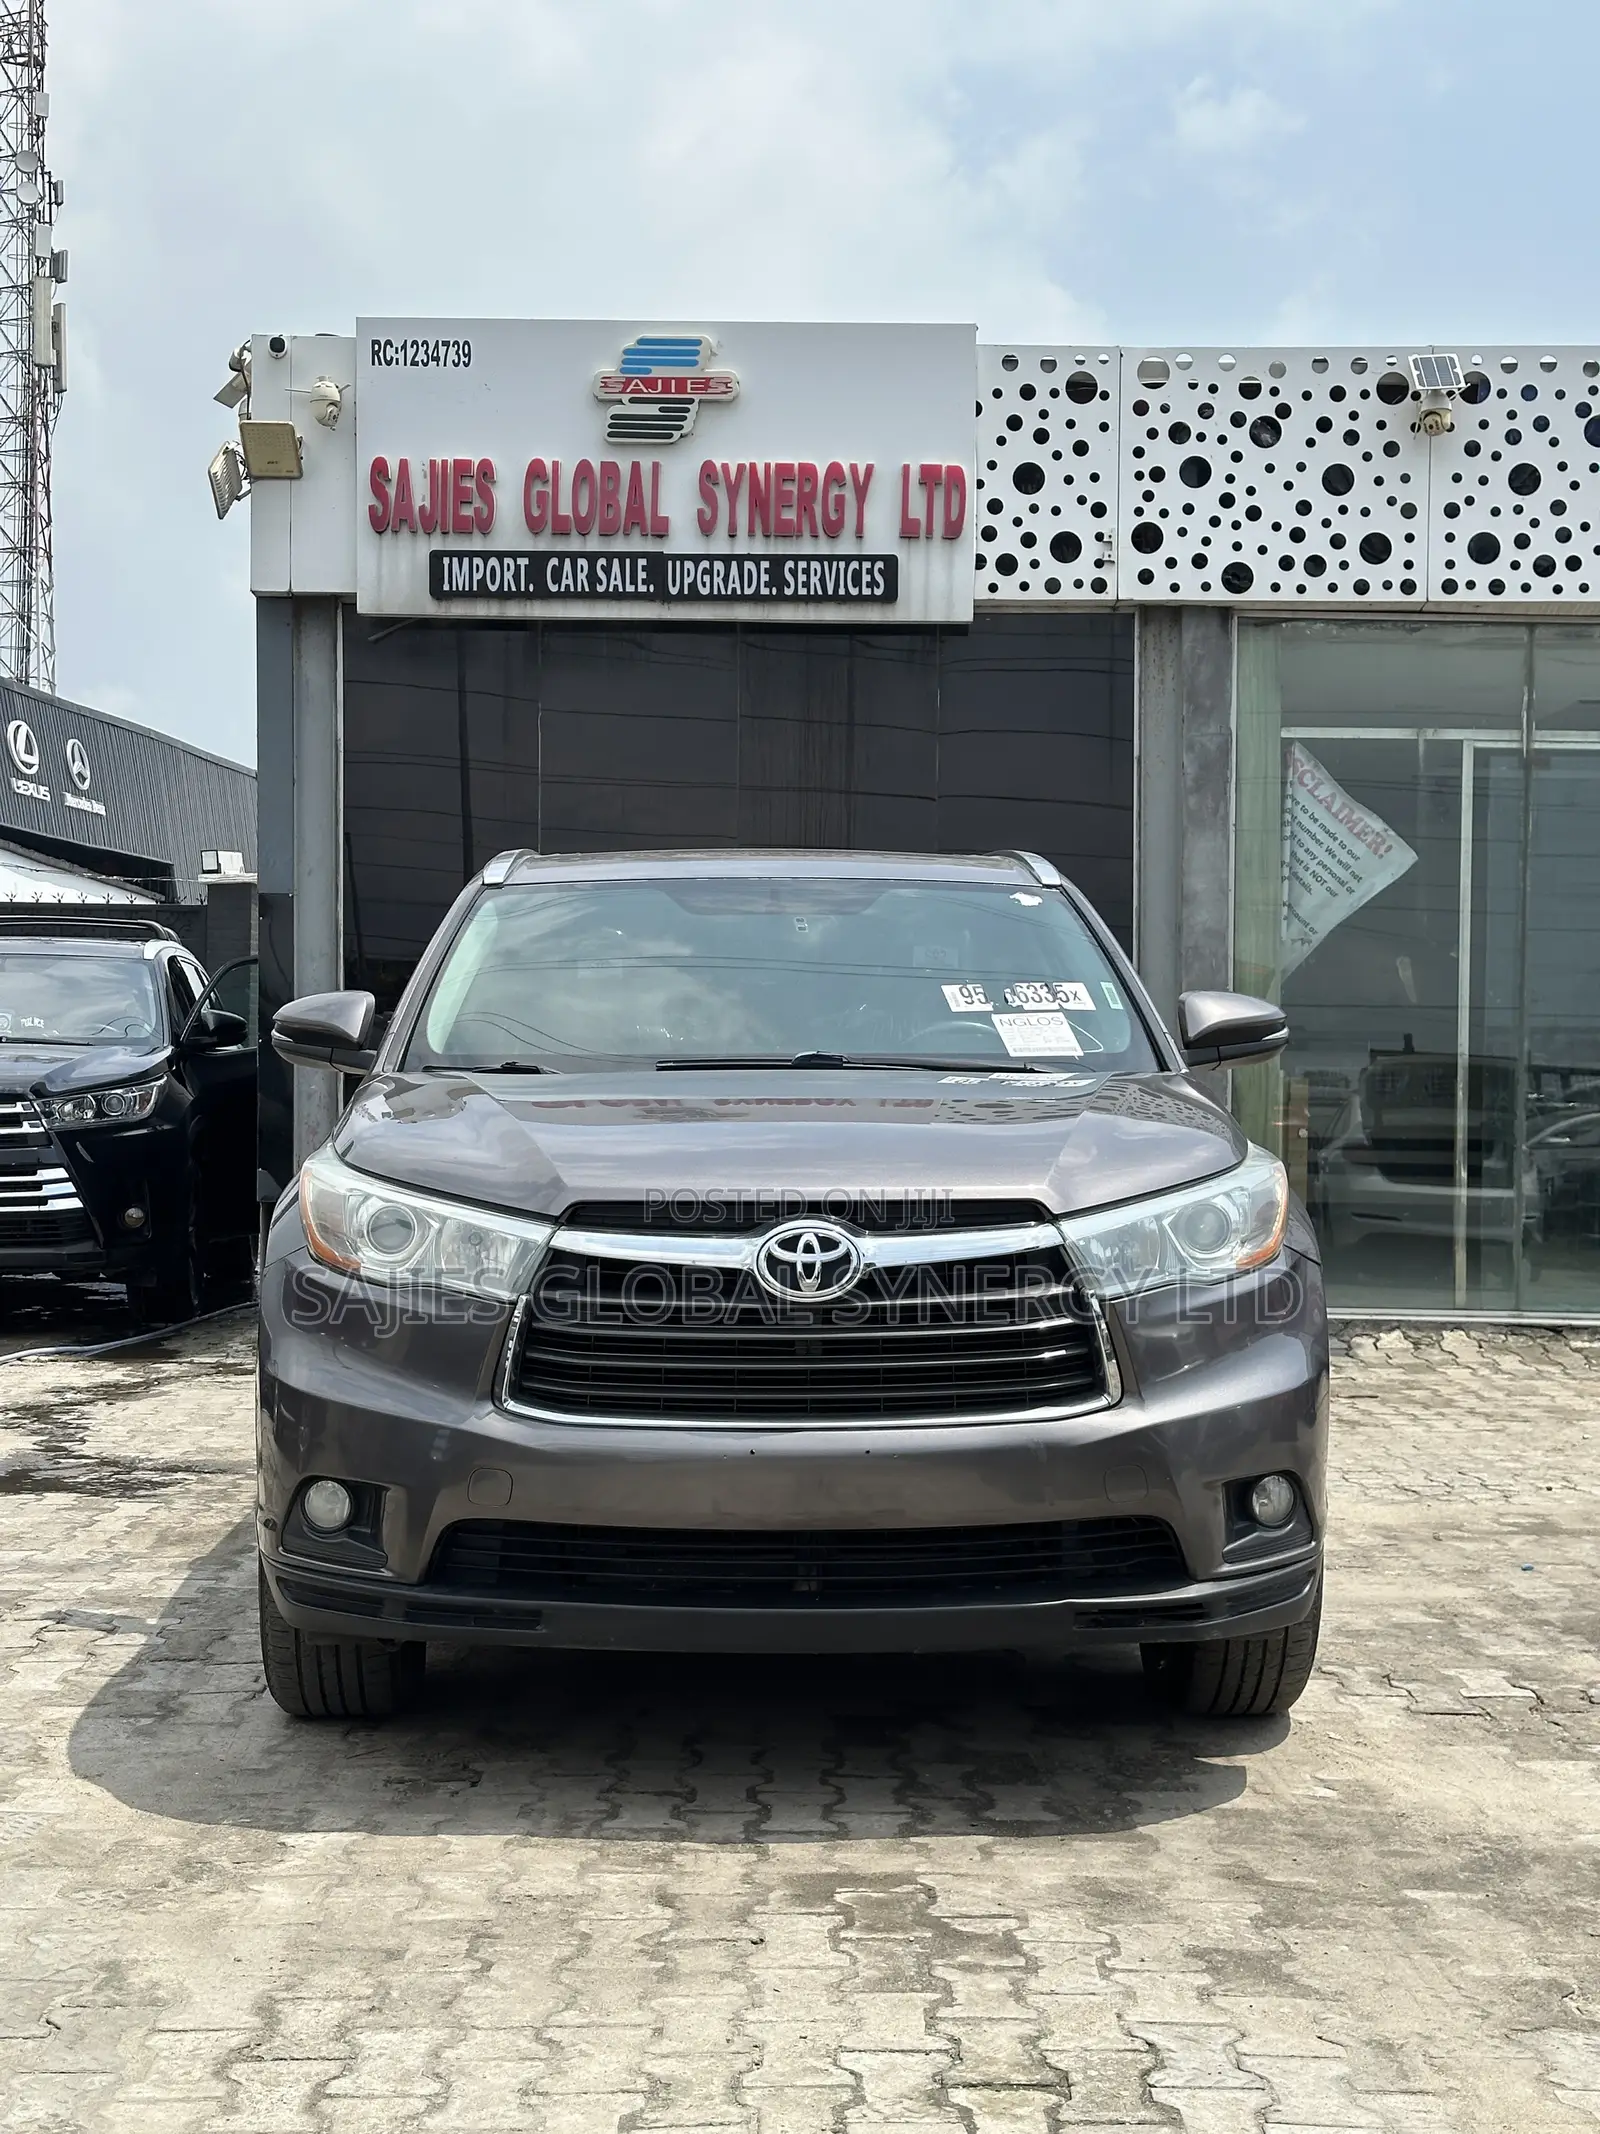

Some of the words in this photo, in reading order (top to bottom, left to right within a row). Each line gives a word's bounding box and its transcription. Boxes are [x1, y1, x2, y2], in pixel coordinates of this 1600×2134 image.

[371, 339, 472, 368] RC:1234739
[599, 376, 734, 395] SAJIES
[368, 456, 497, 534] SAJIES
[523, 457, 670, 537] GLOBAL
[697, 459, 875, 538] SYNERGY
[900, 463, 967, 540] LTD
[442, 556, 534, 593] IMPORT.
[546, 557, 590, 593] CAR
[596, 557, 655, 593] SALE.
[667, 560, 777, 596] UPGRADE.
[783, 560, 885, 596] SERVICES
[1300, 804, 1309, 815] to
[1308, 811, 1320, 824] be
[1317, 822, 1339, 842] made
[1338, 840, 1347, 851] to
[1346, 848, 1361, 861] our
[1296, 837, 1306, 849] to
[1303, 847, 1319, 861] any
[1316, 858, 1349, 889] personal
[1324, 845, 1338, 860] We
[1309, 870, 1328, 887] NOT
[1325, 885, 1339, 898] our
